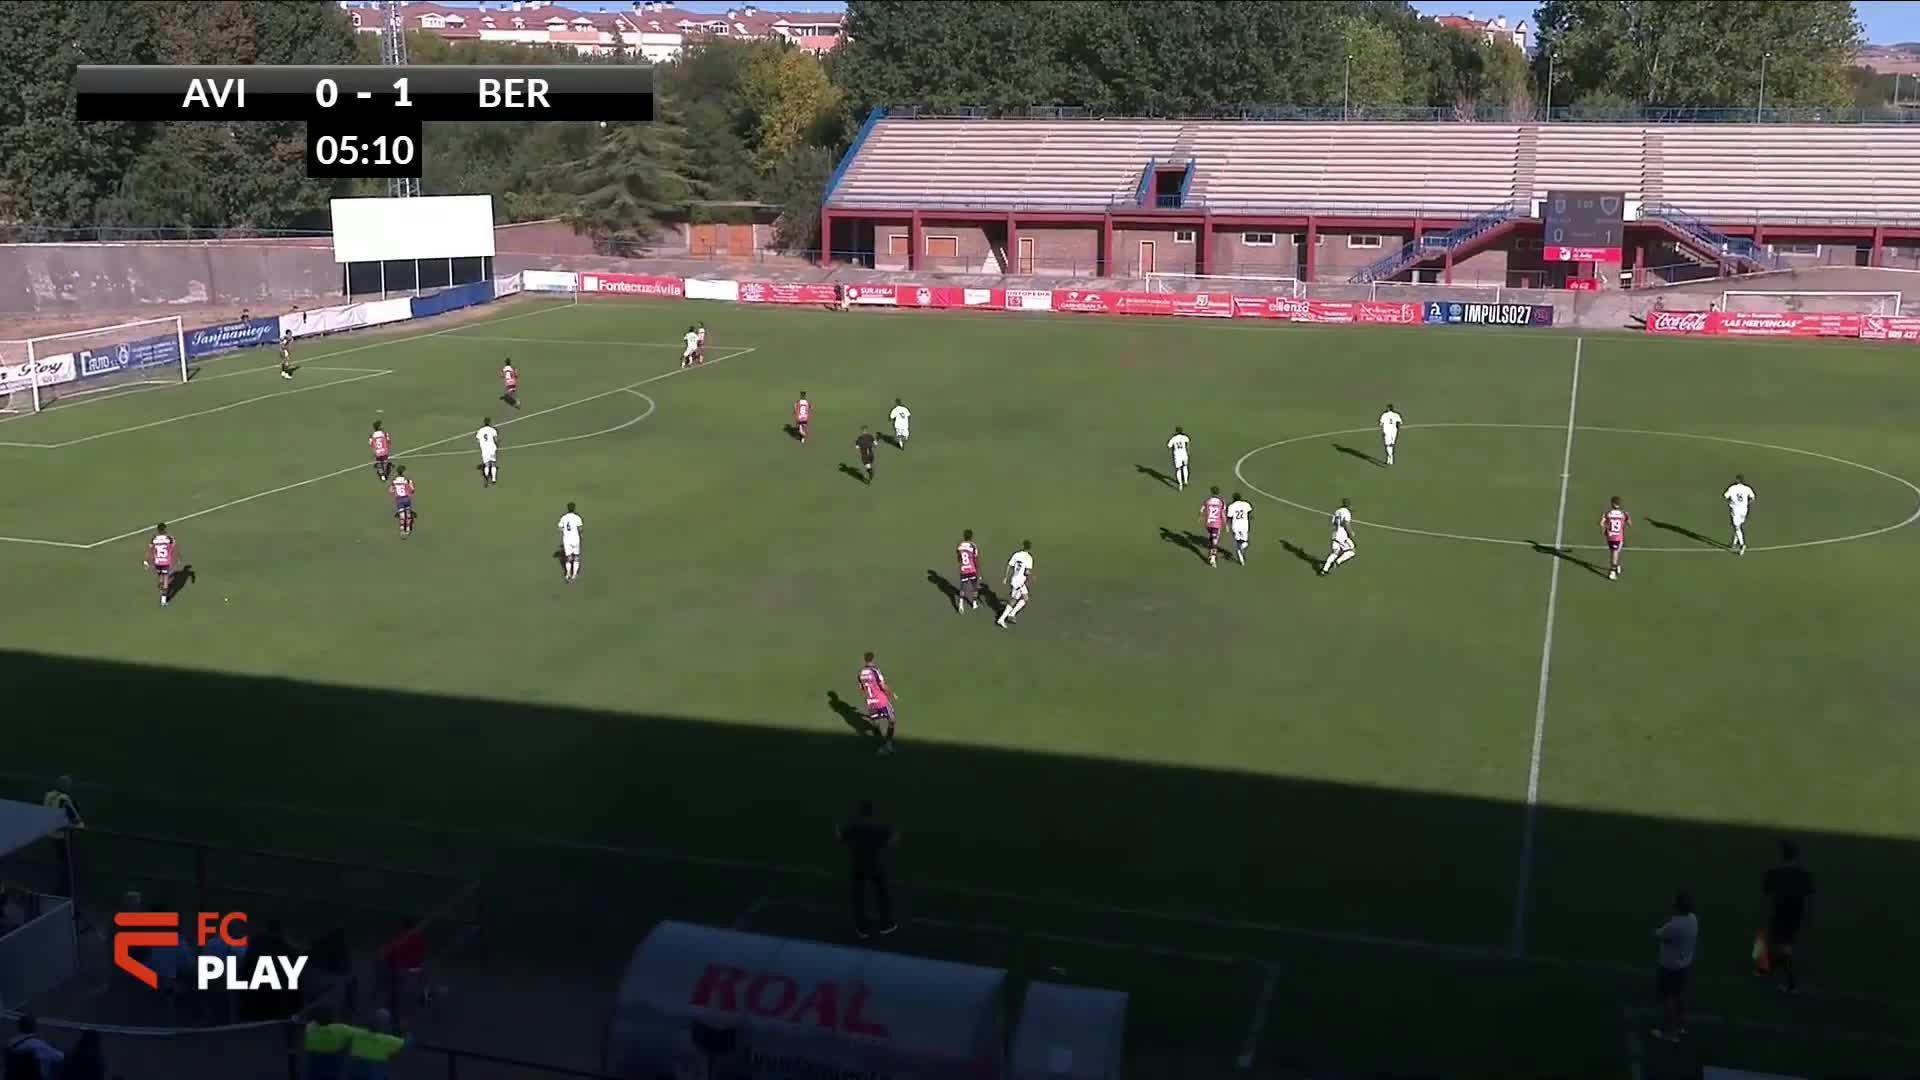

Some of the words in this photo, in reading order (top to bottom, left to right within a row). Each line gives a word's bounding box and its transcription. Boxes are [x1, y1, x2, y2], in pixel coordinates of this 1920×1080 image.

[1464, 304, 1532, 325] IMPULSO27
[191, 324, 272, 346] Sanjuaniego
[1235, 509, 1244, 520] 22
[154, 544, 169, 558] 15
[961, 552, 970, 565] 8
[687, 962, 889, 1038] ROAL
